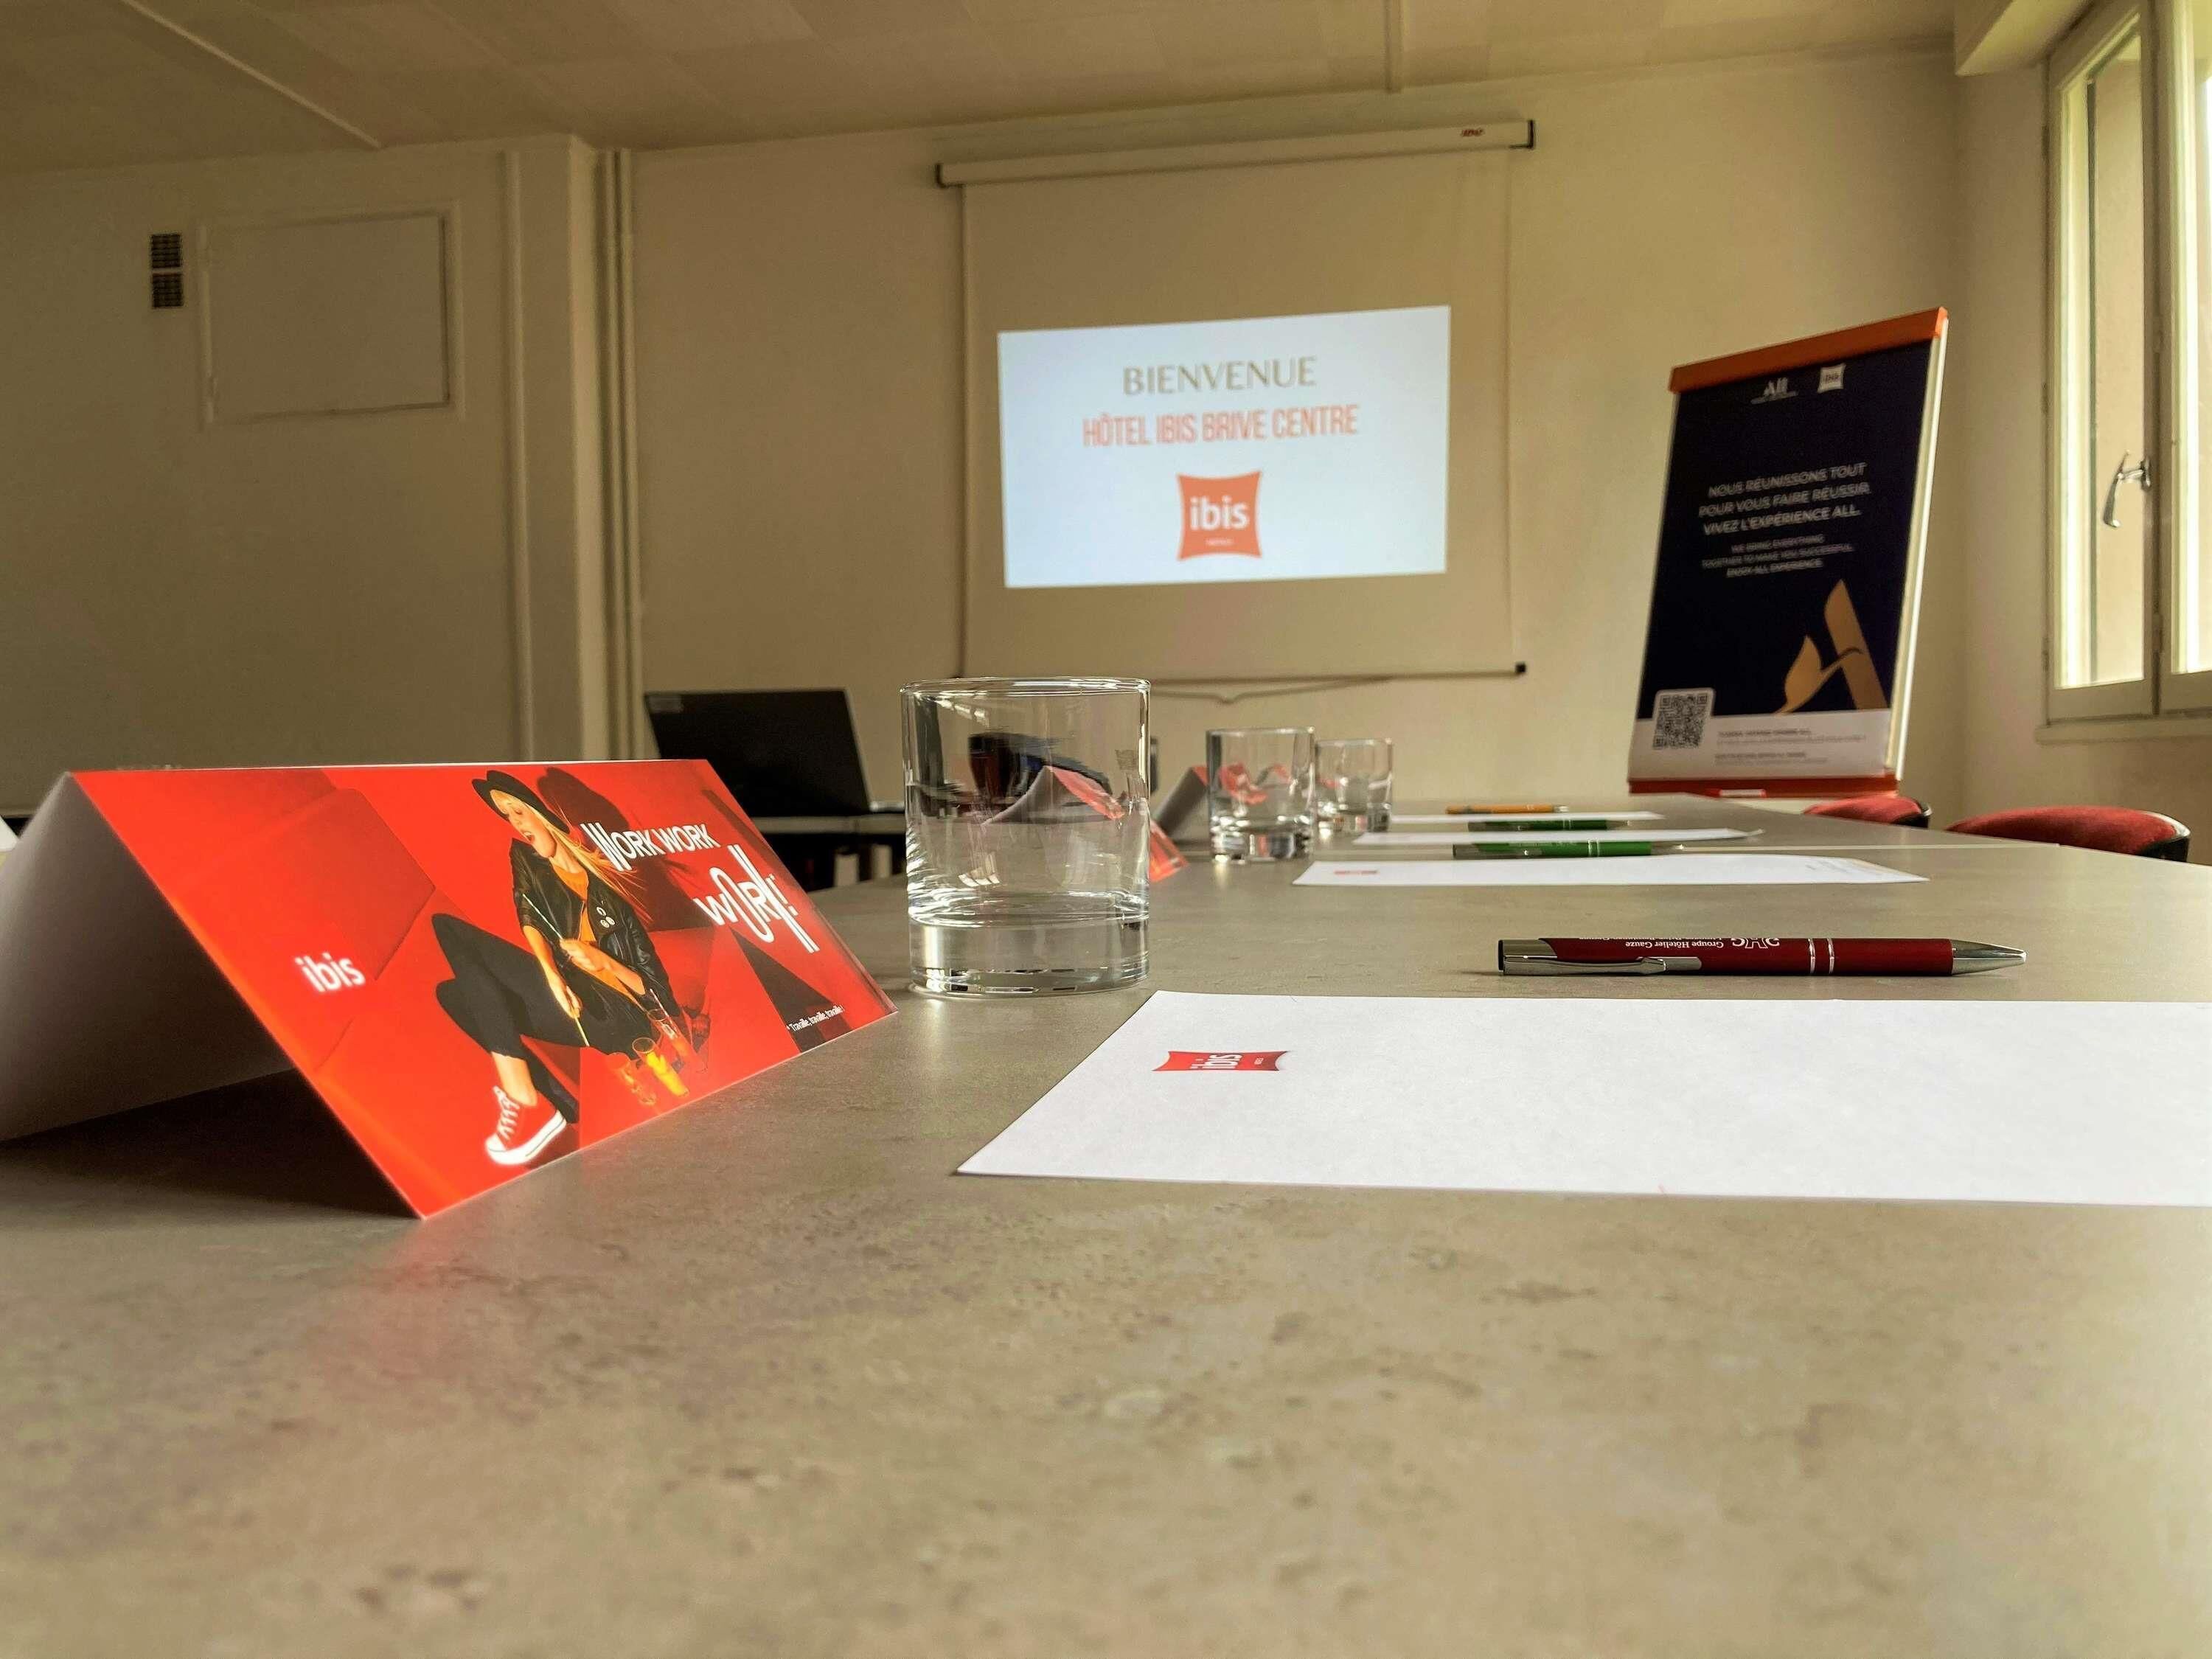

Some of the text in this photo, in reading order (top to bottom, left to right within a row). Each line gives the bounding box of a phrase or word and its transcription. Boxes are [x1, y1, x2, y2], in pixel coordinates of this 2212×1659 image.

[1123, 357, 1318, 395] BIENVENUE
[1082, 404, 1359, 447] HÔTEL IBIS BRIVE CENTRE
[1708, 462, 1868, 498] NOUS RÉUNISSONS TOUT
[1189, 495, 1250, 530] ibis
[1699, 502, 1733, 518] POUR
[1736, 496, 1770, 512] VOUS
[1773, 491, 1809, 507] FAIRE
[1703, 518, 1740, 536] VIVEZ
[580, 822, 721, 872] WORK WORK
[1625, 940, 1724, 949] Groupe Hôtelier Gauze
[294, 951, 366, 993] ibis
